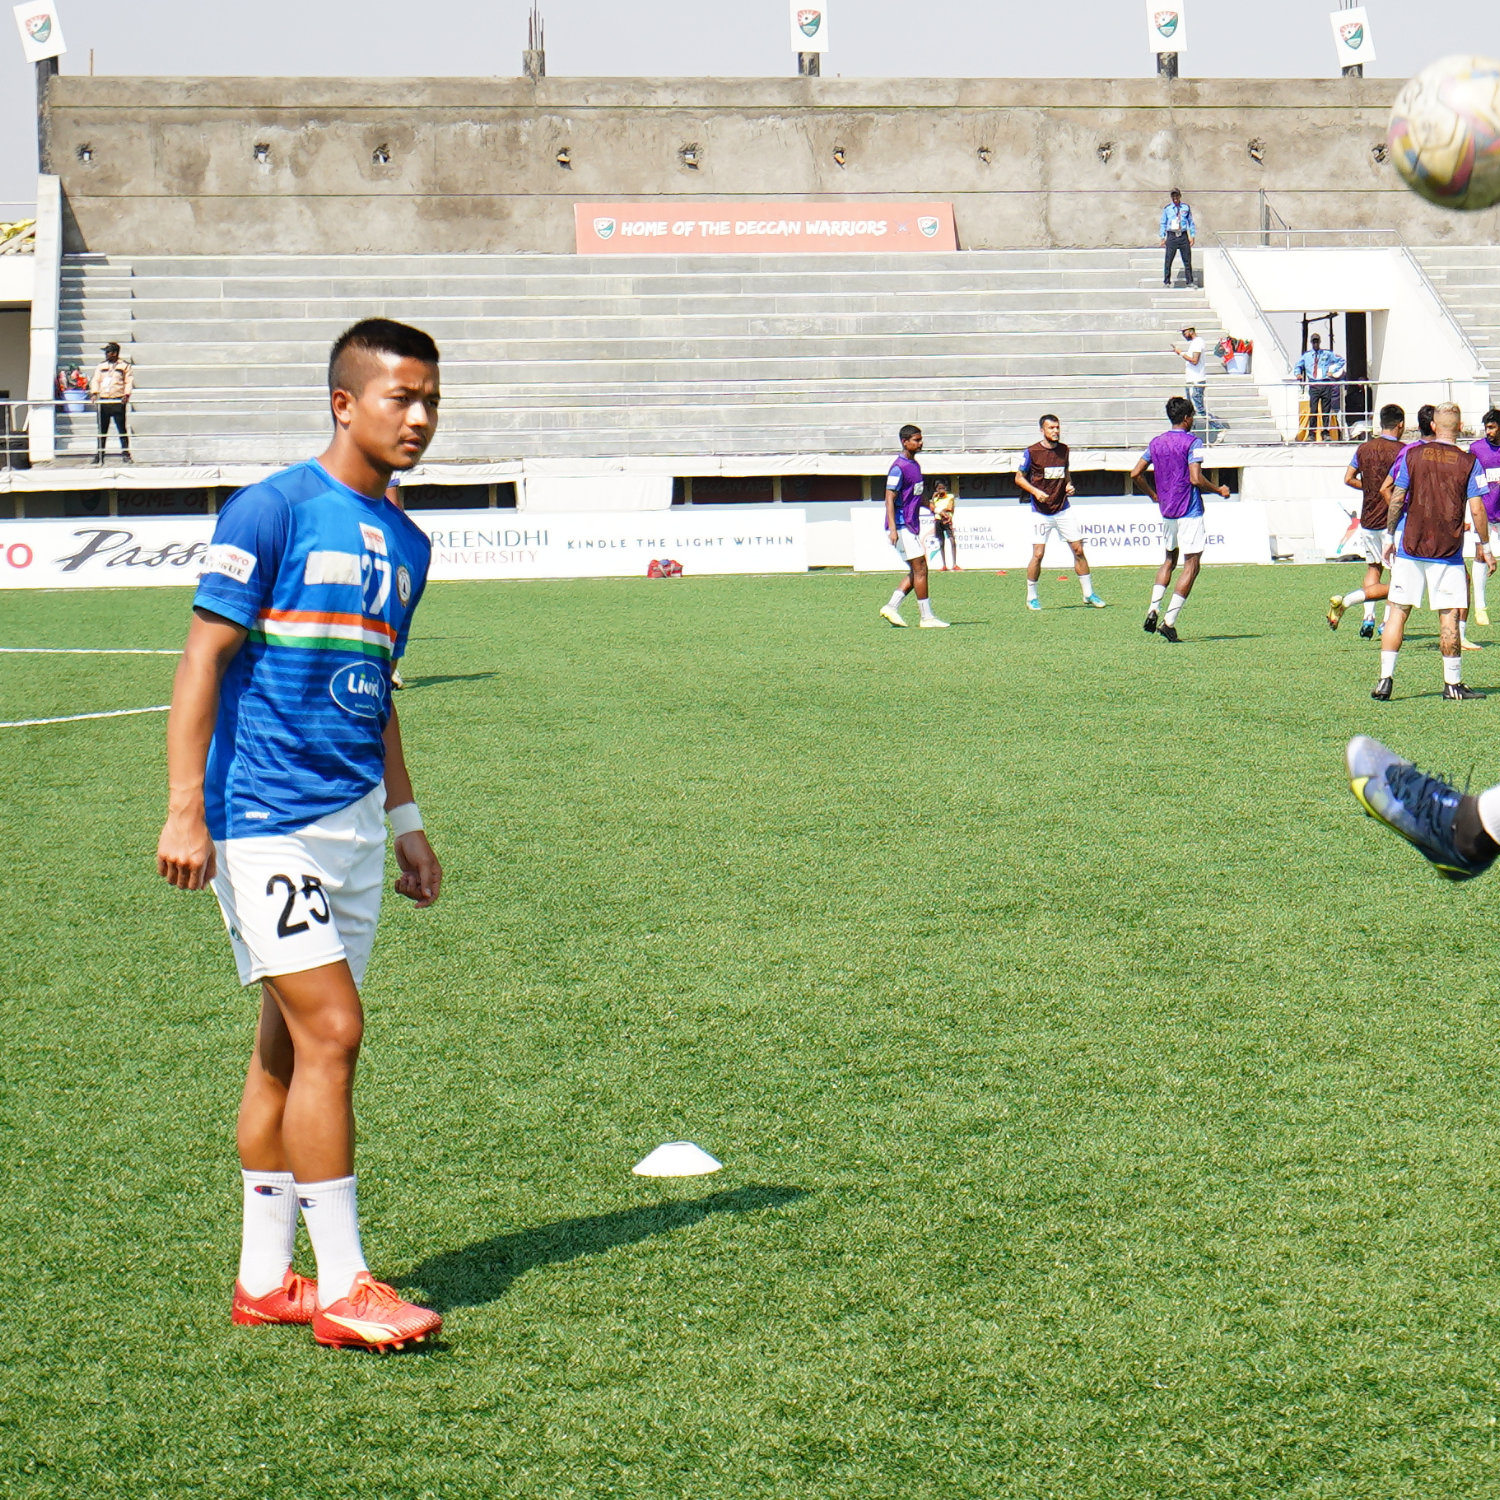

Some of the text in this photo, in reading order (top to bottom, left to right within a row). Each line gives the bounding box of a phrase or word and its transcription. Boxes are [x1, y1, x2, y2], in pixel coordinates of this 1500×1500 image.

[620, 220, 888, 237] HOME OF THE DECCAN WARRIORS
[1033, 523, 1046, 537] 10
[1079, 522, 1164, 535] INDIAN FOOT
[430, 529, 549, 548] REENIDHI
[567, 536, 794, 549] KINDLE THE LIGHT WITHIN
[1082, 535, 1151, 549] FORWARD
[361, 553, 392, 615] 27
[265, 873, 330, 939] 25
